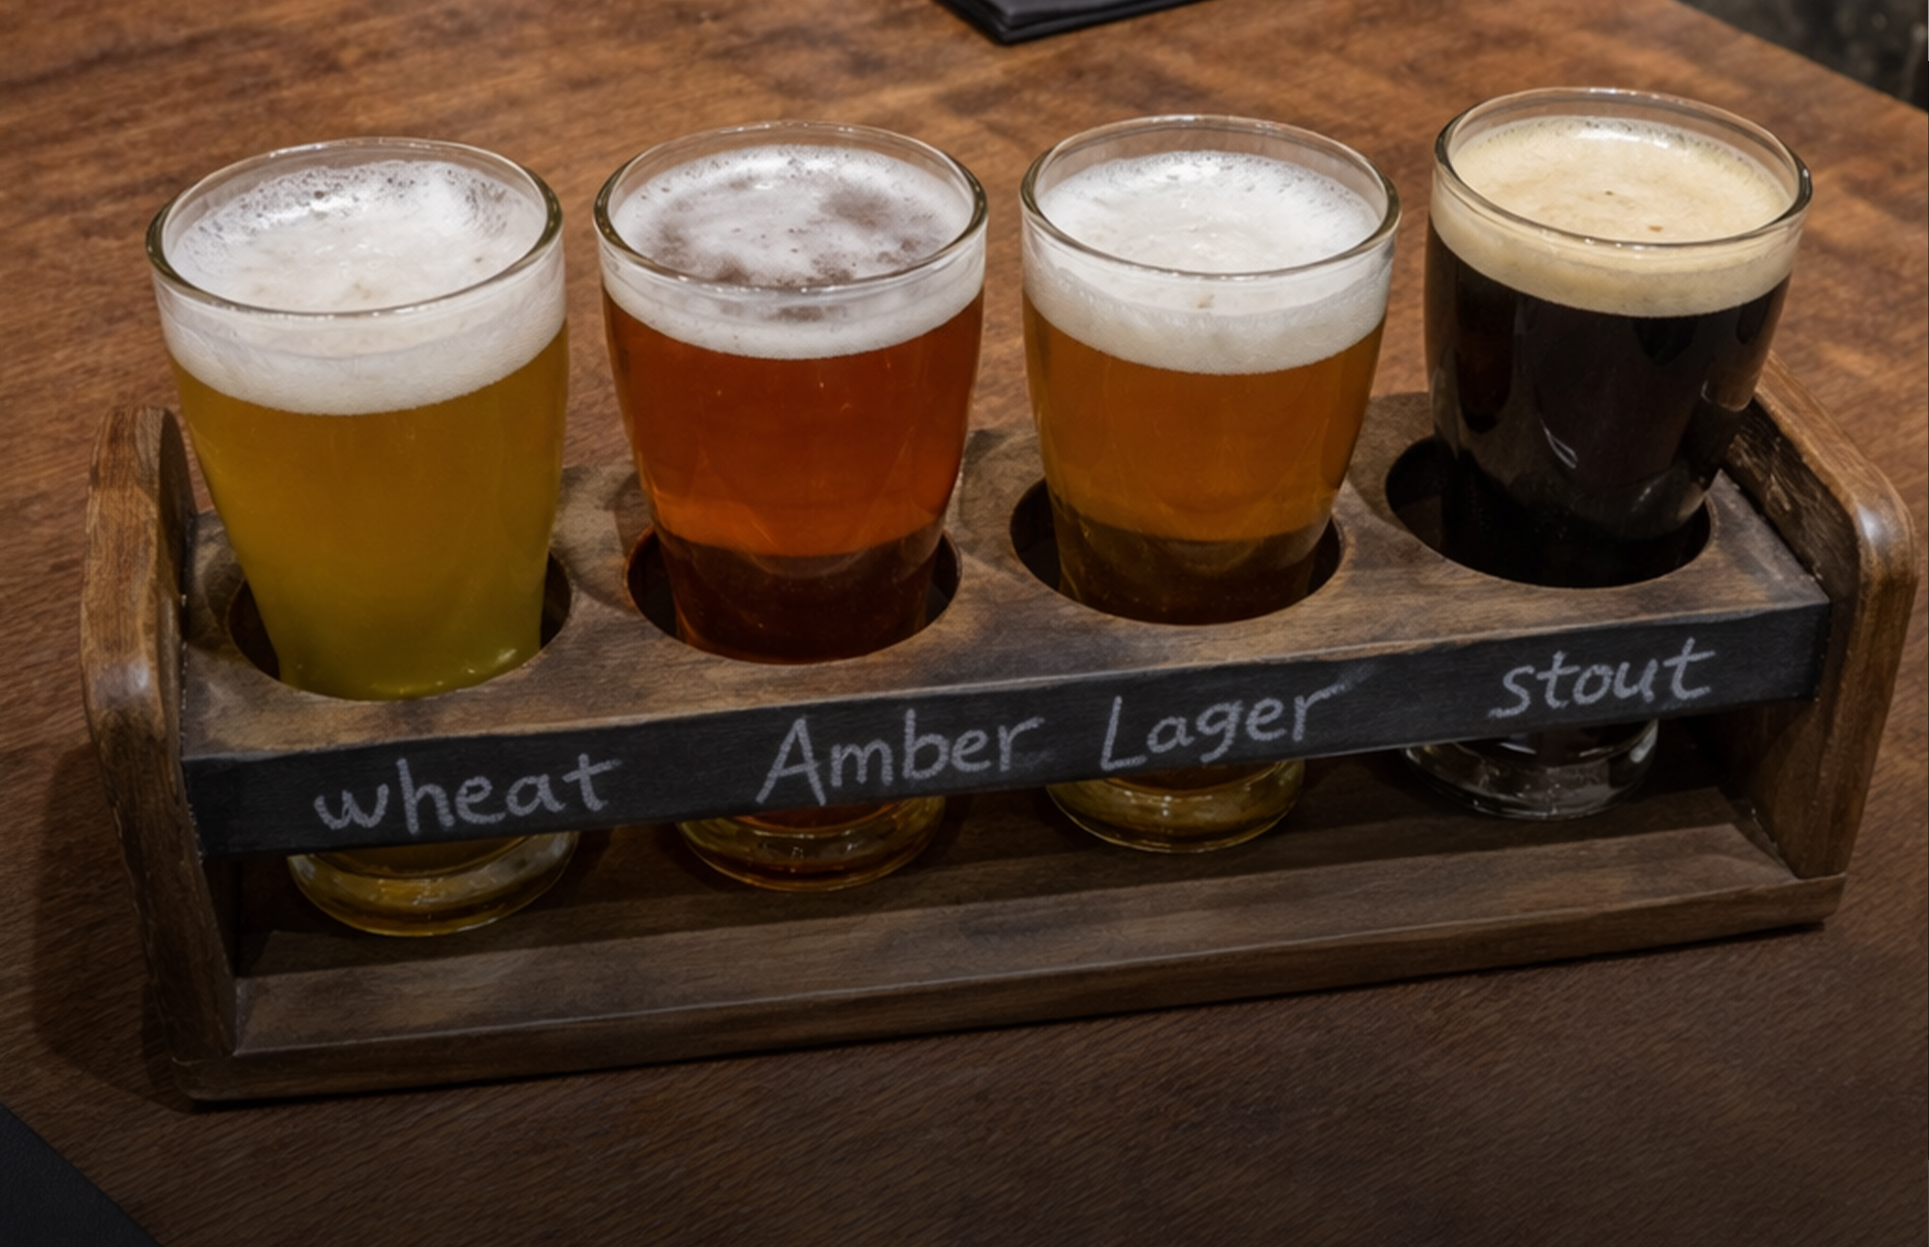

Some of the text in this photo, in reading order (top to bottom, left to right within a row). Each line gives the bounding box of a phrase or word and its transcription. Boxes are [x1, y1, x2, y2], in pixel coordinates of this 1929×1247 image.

[314, 637, 1716, 834] wheat Amber Lager stout
